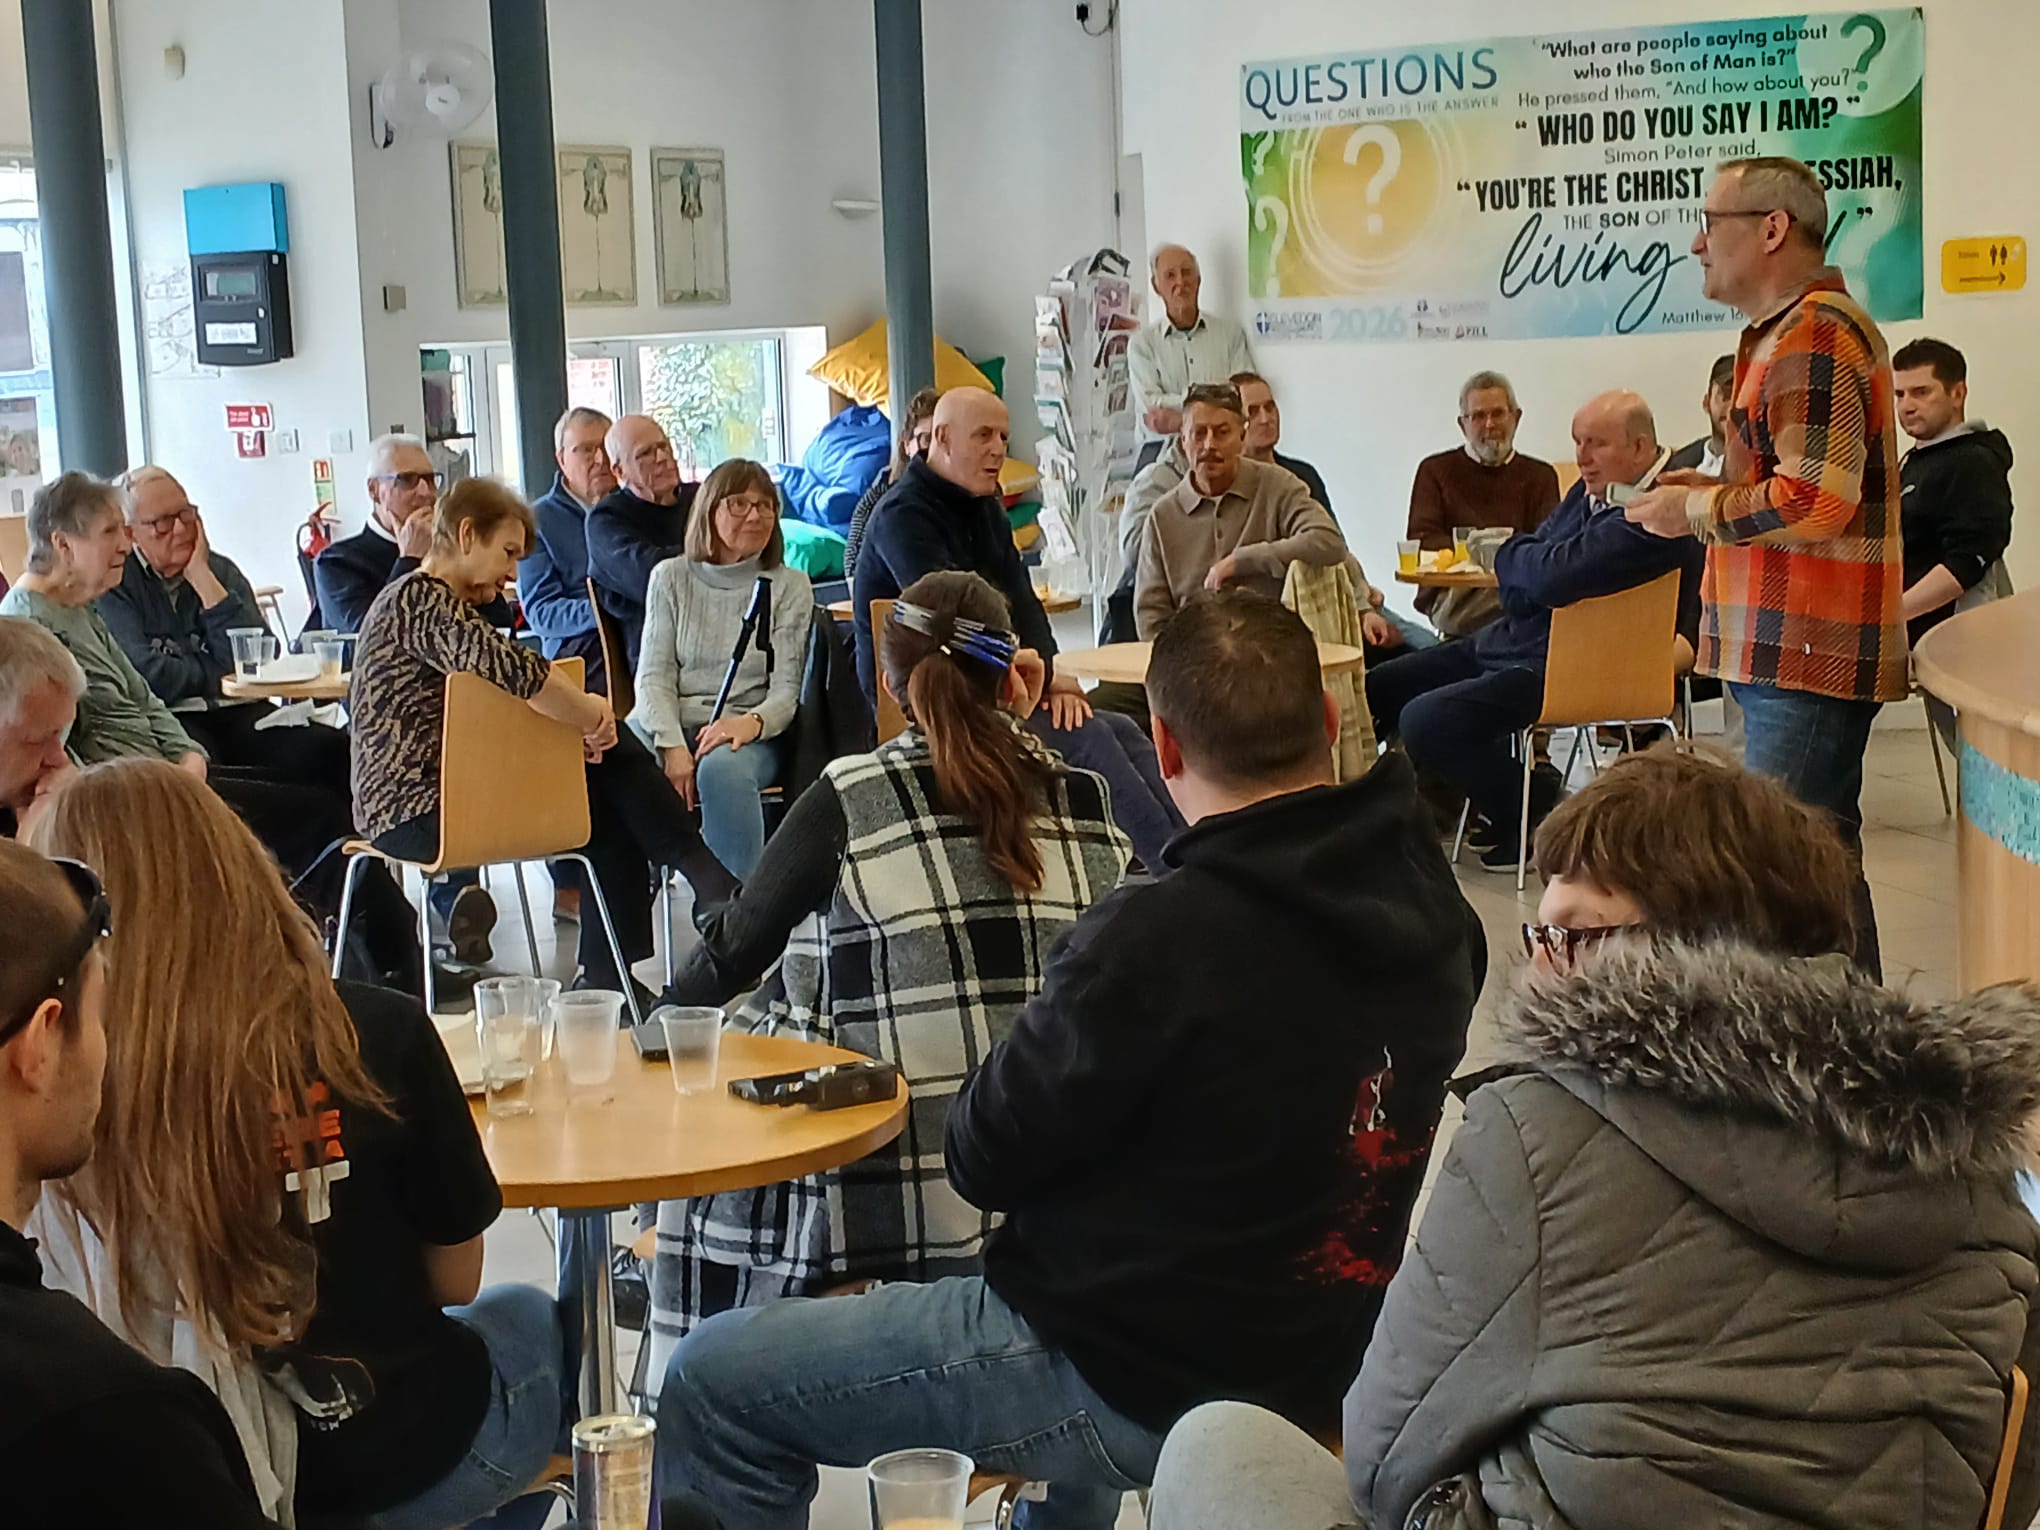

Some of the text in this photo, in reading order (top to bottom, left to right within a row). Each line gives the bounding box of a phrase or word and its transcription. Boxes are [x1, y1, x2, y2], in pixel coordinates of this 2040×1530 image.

[1601, 41, 1631, 54] are
[1637, 31, 1700, 57] people
[1706, 28, 1767, 49] saying
[1773, 24, 1827, 42] about
[1574, 62, 1611, 79] who
[1617, 60, 1645, 77] the
[1650, 58, 1685, 75] Son
[1690, 54, 1708, 71] of
[1714, 53, 1755, 70] Man
[1245, 48, 1498, 121] QUESTIONS
[1518, 92, 1539, 108] He
[1545, 84, 1608, 110] pressed
[1615, 83, 1660, 101] them,
[1713, 75, 1748, 94] how
[1754, 74, 1804, 91] about
[1282, 96, 1498, 124] FROM THE ONE WHO IS THE ANSWER
[1603, 110, 1635, 142] DO
[1644, 105, 1693, 139] YOU
[1702, 101, 1751, 135] SAY
[1760, 100, 1768, 132] I
[1604, 138, 1761, 164] Simon Peter said,
[1564, 172, 1608, 206] THE
[1616, 166, 1706, 204] CHRIST
[1803, 156, 1902, 191] SSIAH,
[1564, 206, 1702, 230] THE SON OF TH
[1499, 211, 1688, 335] living
[1328, 307, 1408, 339] 2026
[1662, 308, 1726, 325] Matthew
